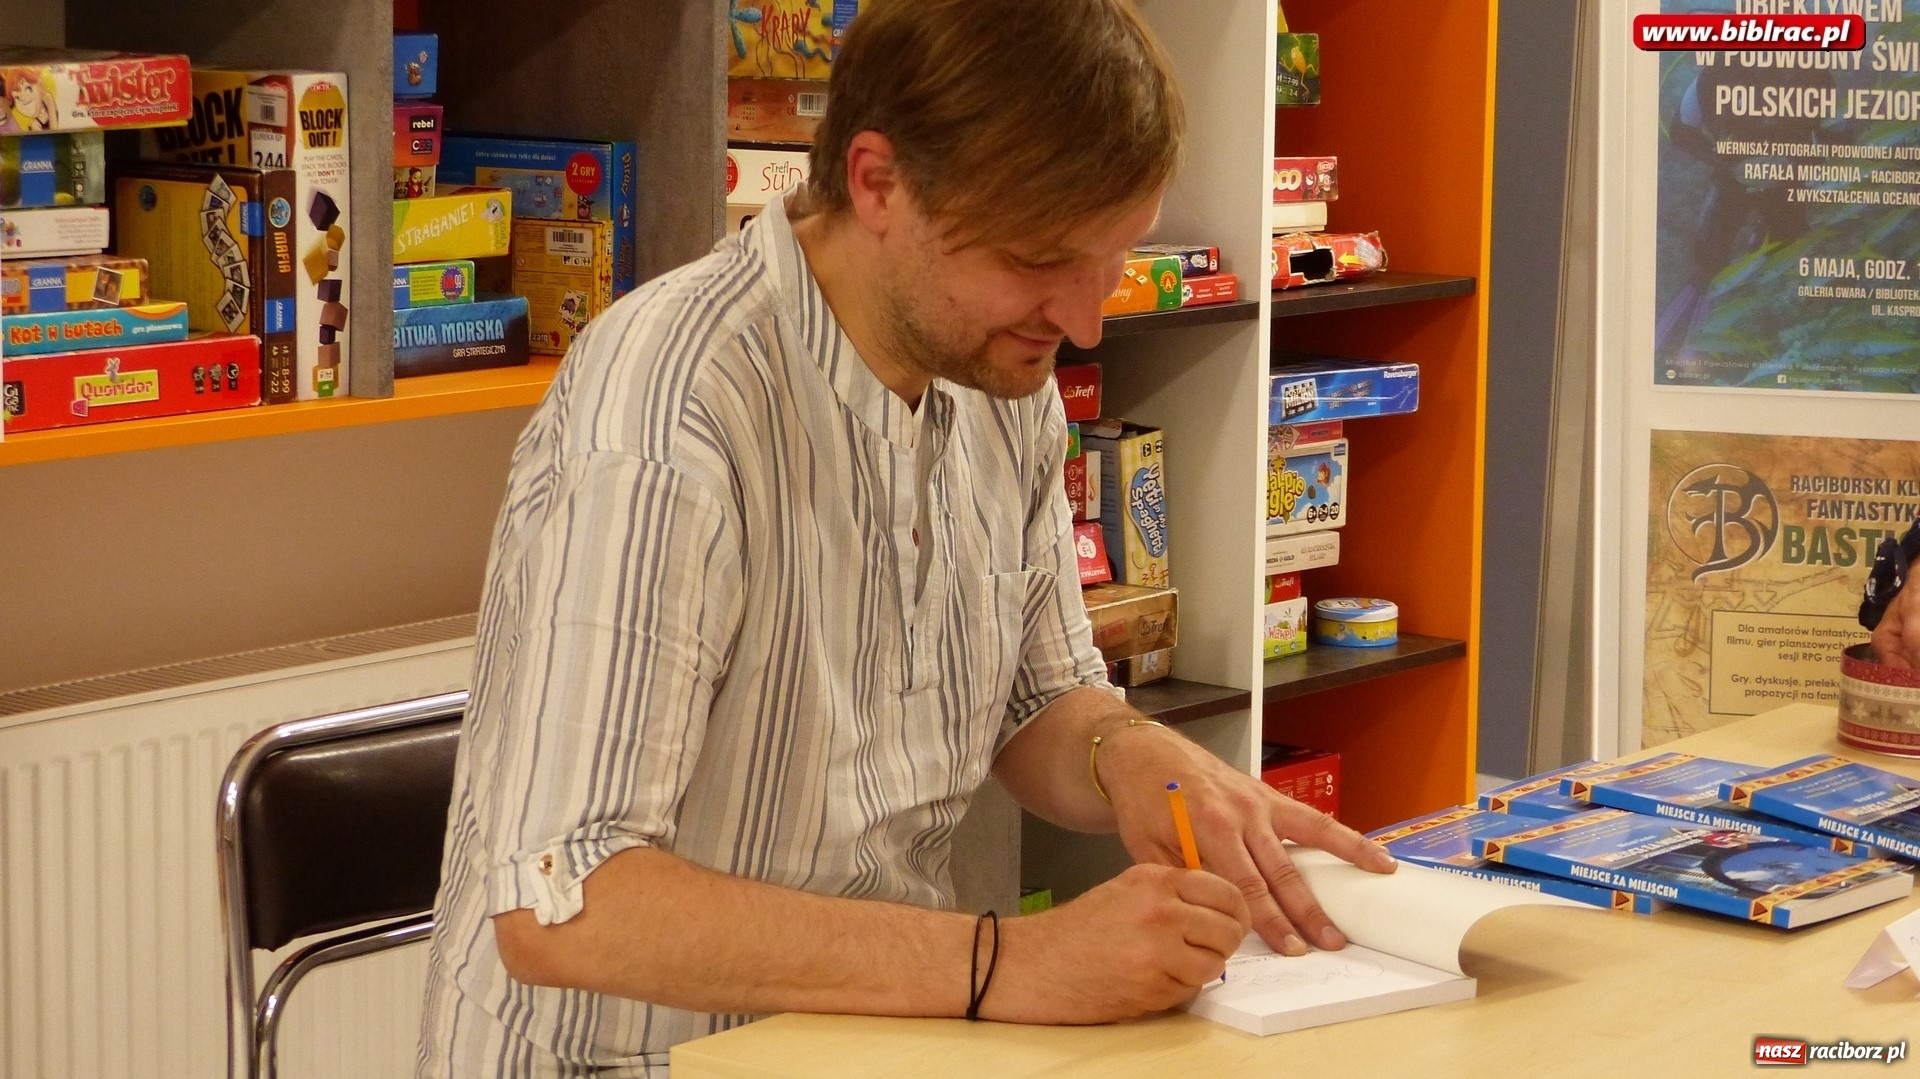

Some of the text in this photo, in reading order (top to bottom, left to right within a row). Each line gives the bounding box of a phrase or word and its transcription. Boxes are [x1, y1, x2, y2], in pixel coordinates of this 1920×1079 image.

[761, 5, 811, 46] KRABY
[67, 60, 176, 108] Twister
[1715, 84, 1837, 119] POLSKICH
[299, 108, 344, 131] BLOCK
[412, 119, 434, 129] rebel
[1716, 140, 1769, 157] WERNISAŻ
[1771, 143, 1829, 158] FOTOGRAFII
[1831, 144, 1892, 160] PODWODNEJ
[23, 160, 54, 171] GRANNA
[572, 162, 596, 177] 2 GRY
[770, 160, 789, 174] Trefl
[1744, 163, 1794, 181] RAFAŁA
[1797, 165, 1861, 183] MICHONIA
[1787, 188, 1794, 202] Z
[1796, 190, 1880, 204] WYKSZTAŁCENIA
[273, 231, 292, 274] MAFIA
[1799, 257, 1809, 277] 6
[1813, 257, 1860, 280] MAJA,
[1865, 259, 1911, 280] GODZ.
[32, 278, 62, 287] GRANNA
[1798, 285, 1834, 298] GALERIA
[1835, 287, 1866, 299] GWARA
[1875, 288, 1920, 301] BIBLIOTEK
[10, 325, 43, 345] Kot
[63, 318, 123, 340] butach
[394, 324, 438, 349] BITWA
[441, 319, 505, 344] MORSKA
[453, 345, 506, 358] GRA STRATEGICZNA
[270, 371, 280, 394] 7-22
[281, 367, 291, 394] 8-99
[1383, 370, 1418, 380] Ravensburger
[80, 379, 153, 400] Quoridor
[1074, 385, 1095, 399] Trefl
[1143, 462, 1163, 509] Yeti
[1791, 474, 1920, 497] RACIBORSKI KL
[1131, 486, 1164, 557] Spaghetti
[1782, 524, 1895, 569] BAST
[1738, 624, 1755, 633] Dla
[1757, 626, 1809, 636] amatorów
[1726, 635, 1754, 646] filmu,
[1756, 638, 1776, 648] gier
[1778, 639, 1845, 651] planszowych
[1778, 652, 1799, 662] sesji
[1802, 652, 1822, 662] RPG
[1730, 674, 1752, 685] Gry,
[1755, 675, 1801, 687] dyskusje,
[1744, 689, 1799, 700] propozycji
[1656, 803, 1761, 836] MIEJSCE ZA MIEJSCEM
[1818, 817, 1860, 838] MIEJSCE
[1861, 830, 1875, 844] ZA
[1570, 864, 1679, 899] MIEJSCE ZA MIEJSCEM
